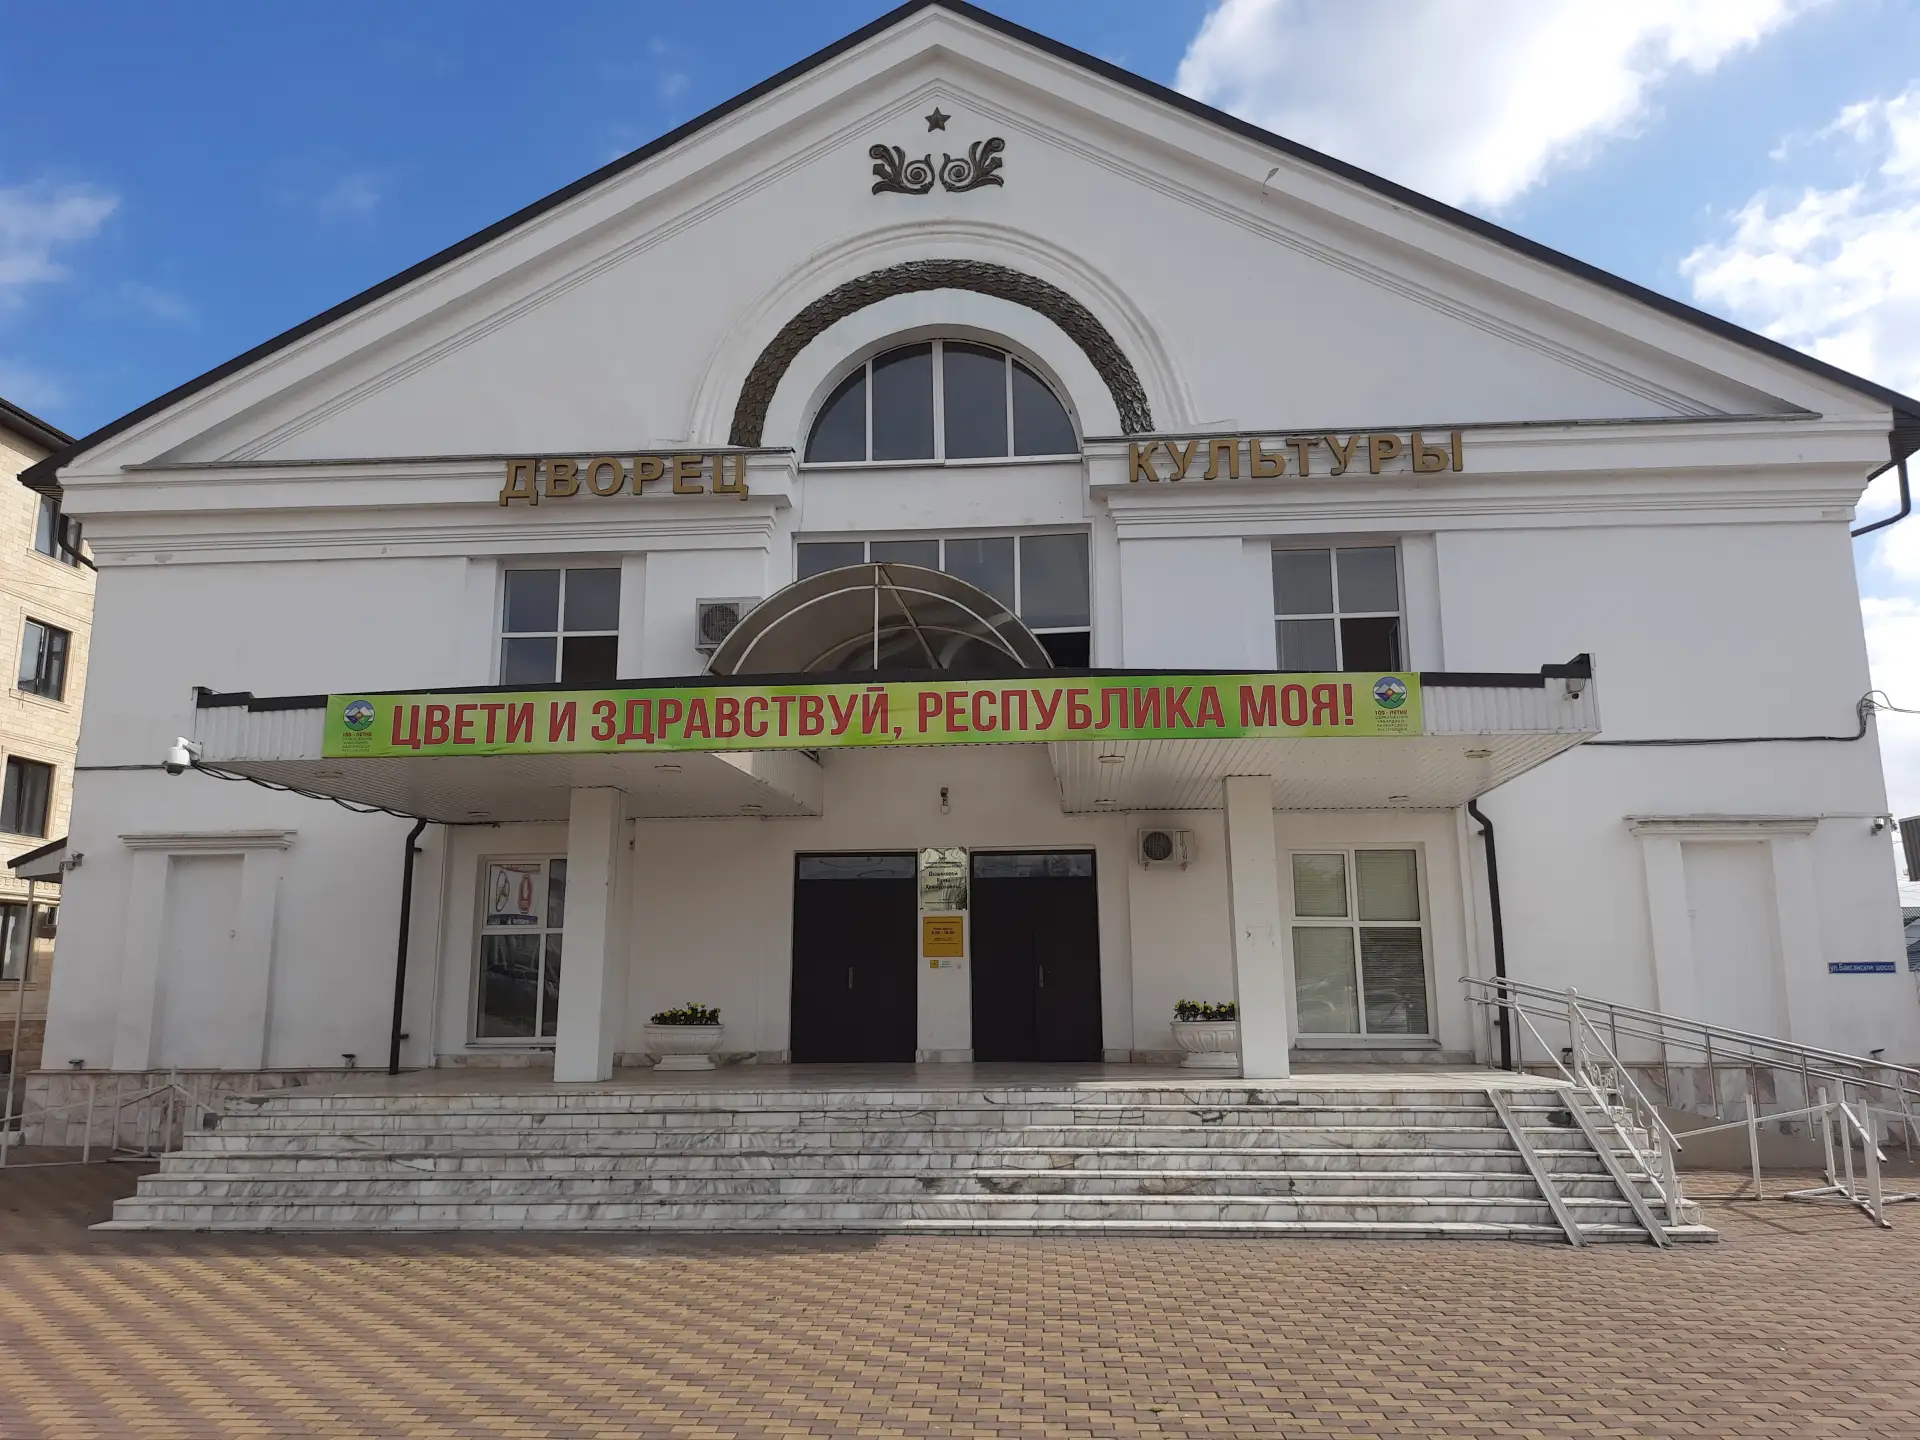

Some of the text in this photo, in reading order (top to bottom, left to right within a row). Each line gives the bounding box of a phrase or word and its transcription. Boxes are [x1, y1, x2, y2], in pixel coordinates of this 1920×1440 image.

[500, 430, 1464, 506] ДВОРЕЦ КУЛЬТУРЫ
[391, 683, 1354, 750] ЦВЕТИ И ЗДРАВСТВУЙ, РЕСПУБЛИКА МОЯ!
